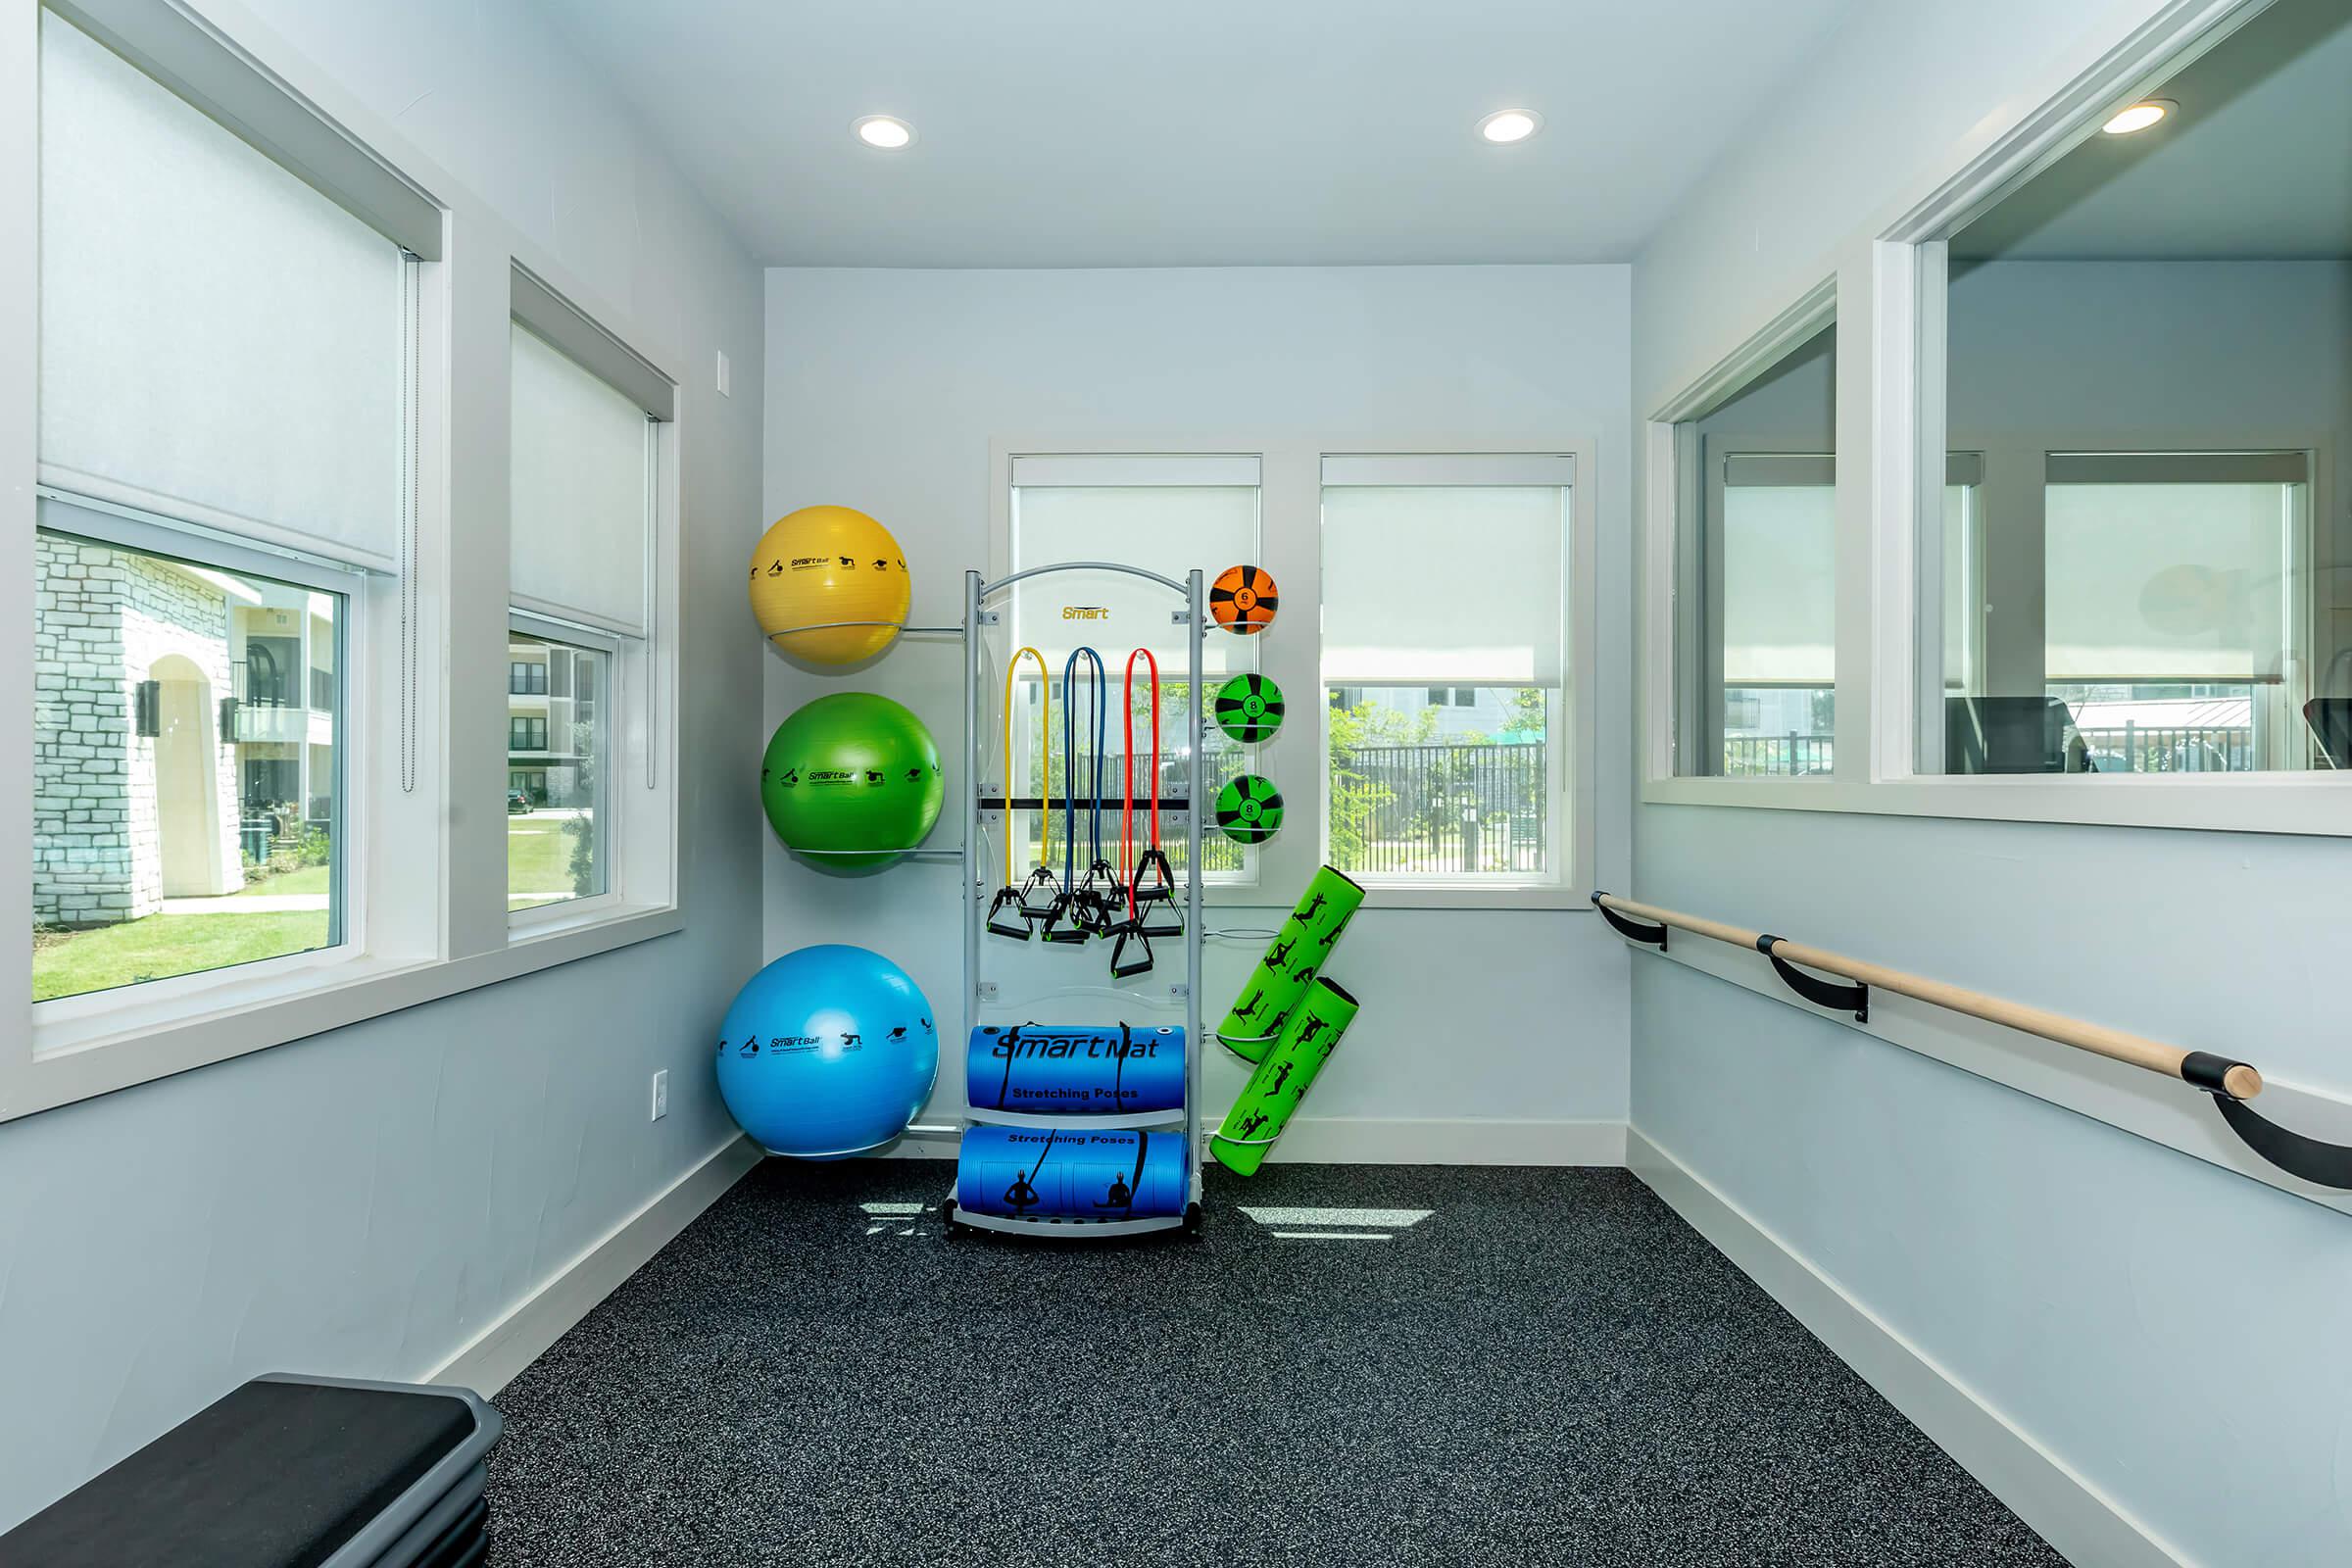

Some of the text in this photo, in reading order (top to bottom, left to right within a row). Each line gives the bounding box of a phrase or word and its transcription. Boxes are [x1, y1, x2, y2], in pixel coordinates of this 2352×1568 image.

[1241, 592, 1249, 601] 6
[1062, 606, 1109, 619] Smart
[808, 771, 839, 780] Smart
[1246, 804, 1253, 813] 8
[770, 1036, 820, 1048] Smart Ball
[1012, 1087, 1139, 1101] Stretching Poses
[1007, 1133, 1136, 1146] Stretching Poses
